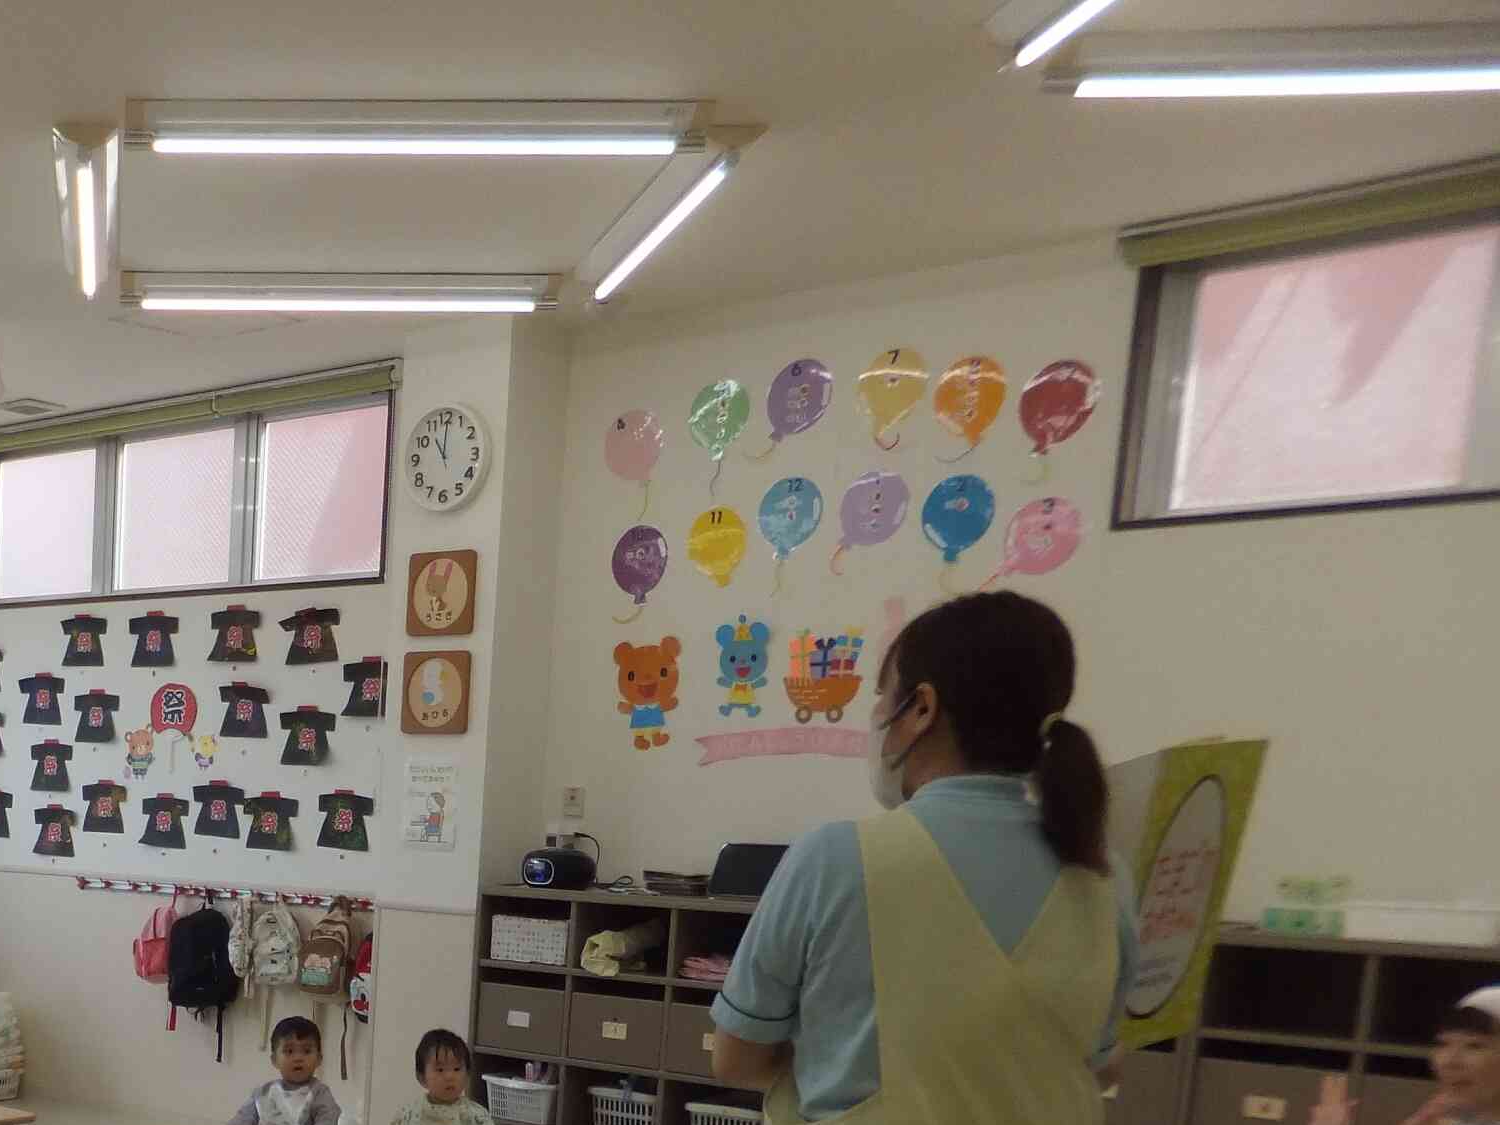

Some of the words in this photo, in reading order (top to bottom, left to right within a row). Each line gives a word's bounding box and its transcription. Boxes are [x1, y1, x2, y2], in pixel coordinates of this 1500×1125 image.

[888, 350, 899, 365] 7
[791, 363, 802, 377] 6
[438, 411, 453, 425] 12
[457, 415, 463, 427] 1
[426, 420, 437, 432] 11
[466, 426, 475, 440] 2
[416, 436, 430, 449] 10
[411, 454, 420, 467] 9
[470, 447, 480, 461] 3
[414, 472, 424, 487] 8
[464, 466, 474, 480] 4
[426, 486, 434, 498] 7
[455, 483, 463, 496] 5
[788, 478, 803, 493] 12
[438, 490, 448, 503] 6
[710, 511, 723, 524] 11
[162, 689, 186, 724] 祭
